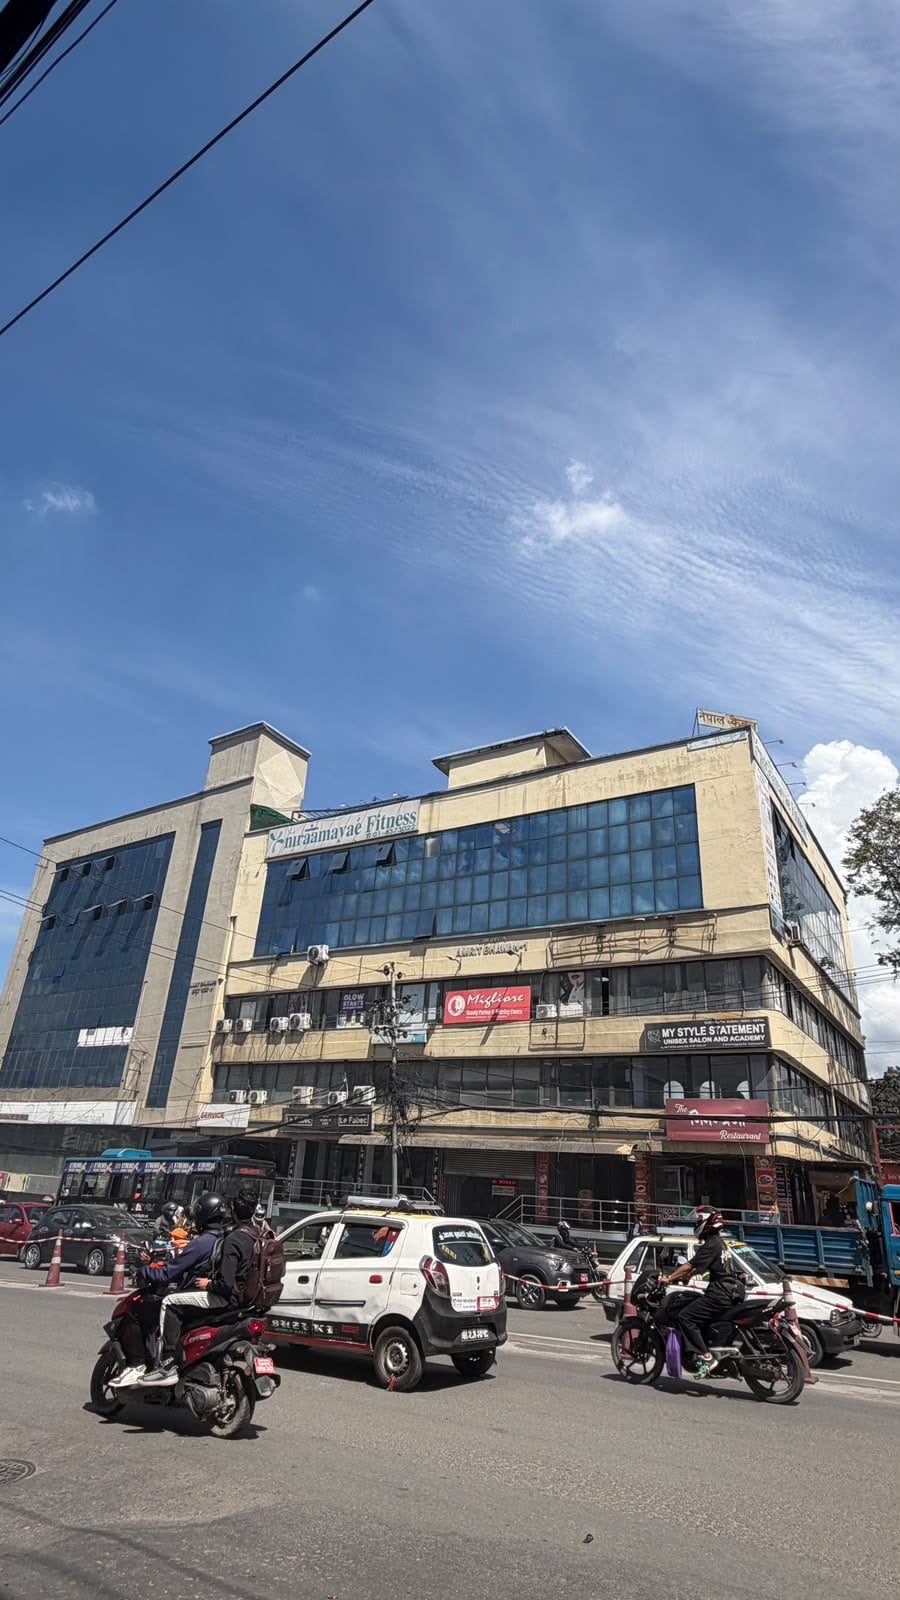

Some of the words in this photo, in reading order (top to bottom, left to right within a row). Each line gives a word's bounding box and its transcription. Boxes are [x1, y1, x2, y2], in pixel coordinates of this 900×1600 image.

[366, 811, 417, 833] Fitness
[343, 993, 364, 1001] GLOW
[662, 1028, 675, 1038] MY
[677, 1026, 706, 1037] STYLE
[709, 1024, 766, 1035] STATEMENT
[730, 1034, 766, 1042] ACADEMY
[674, 1103, 688, 1113] The
[200, 1111, 225, 1119] SERVICE
[720, 1130, 762, 1140] Restaurant
